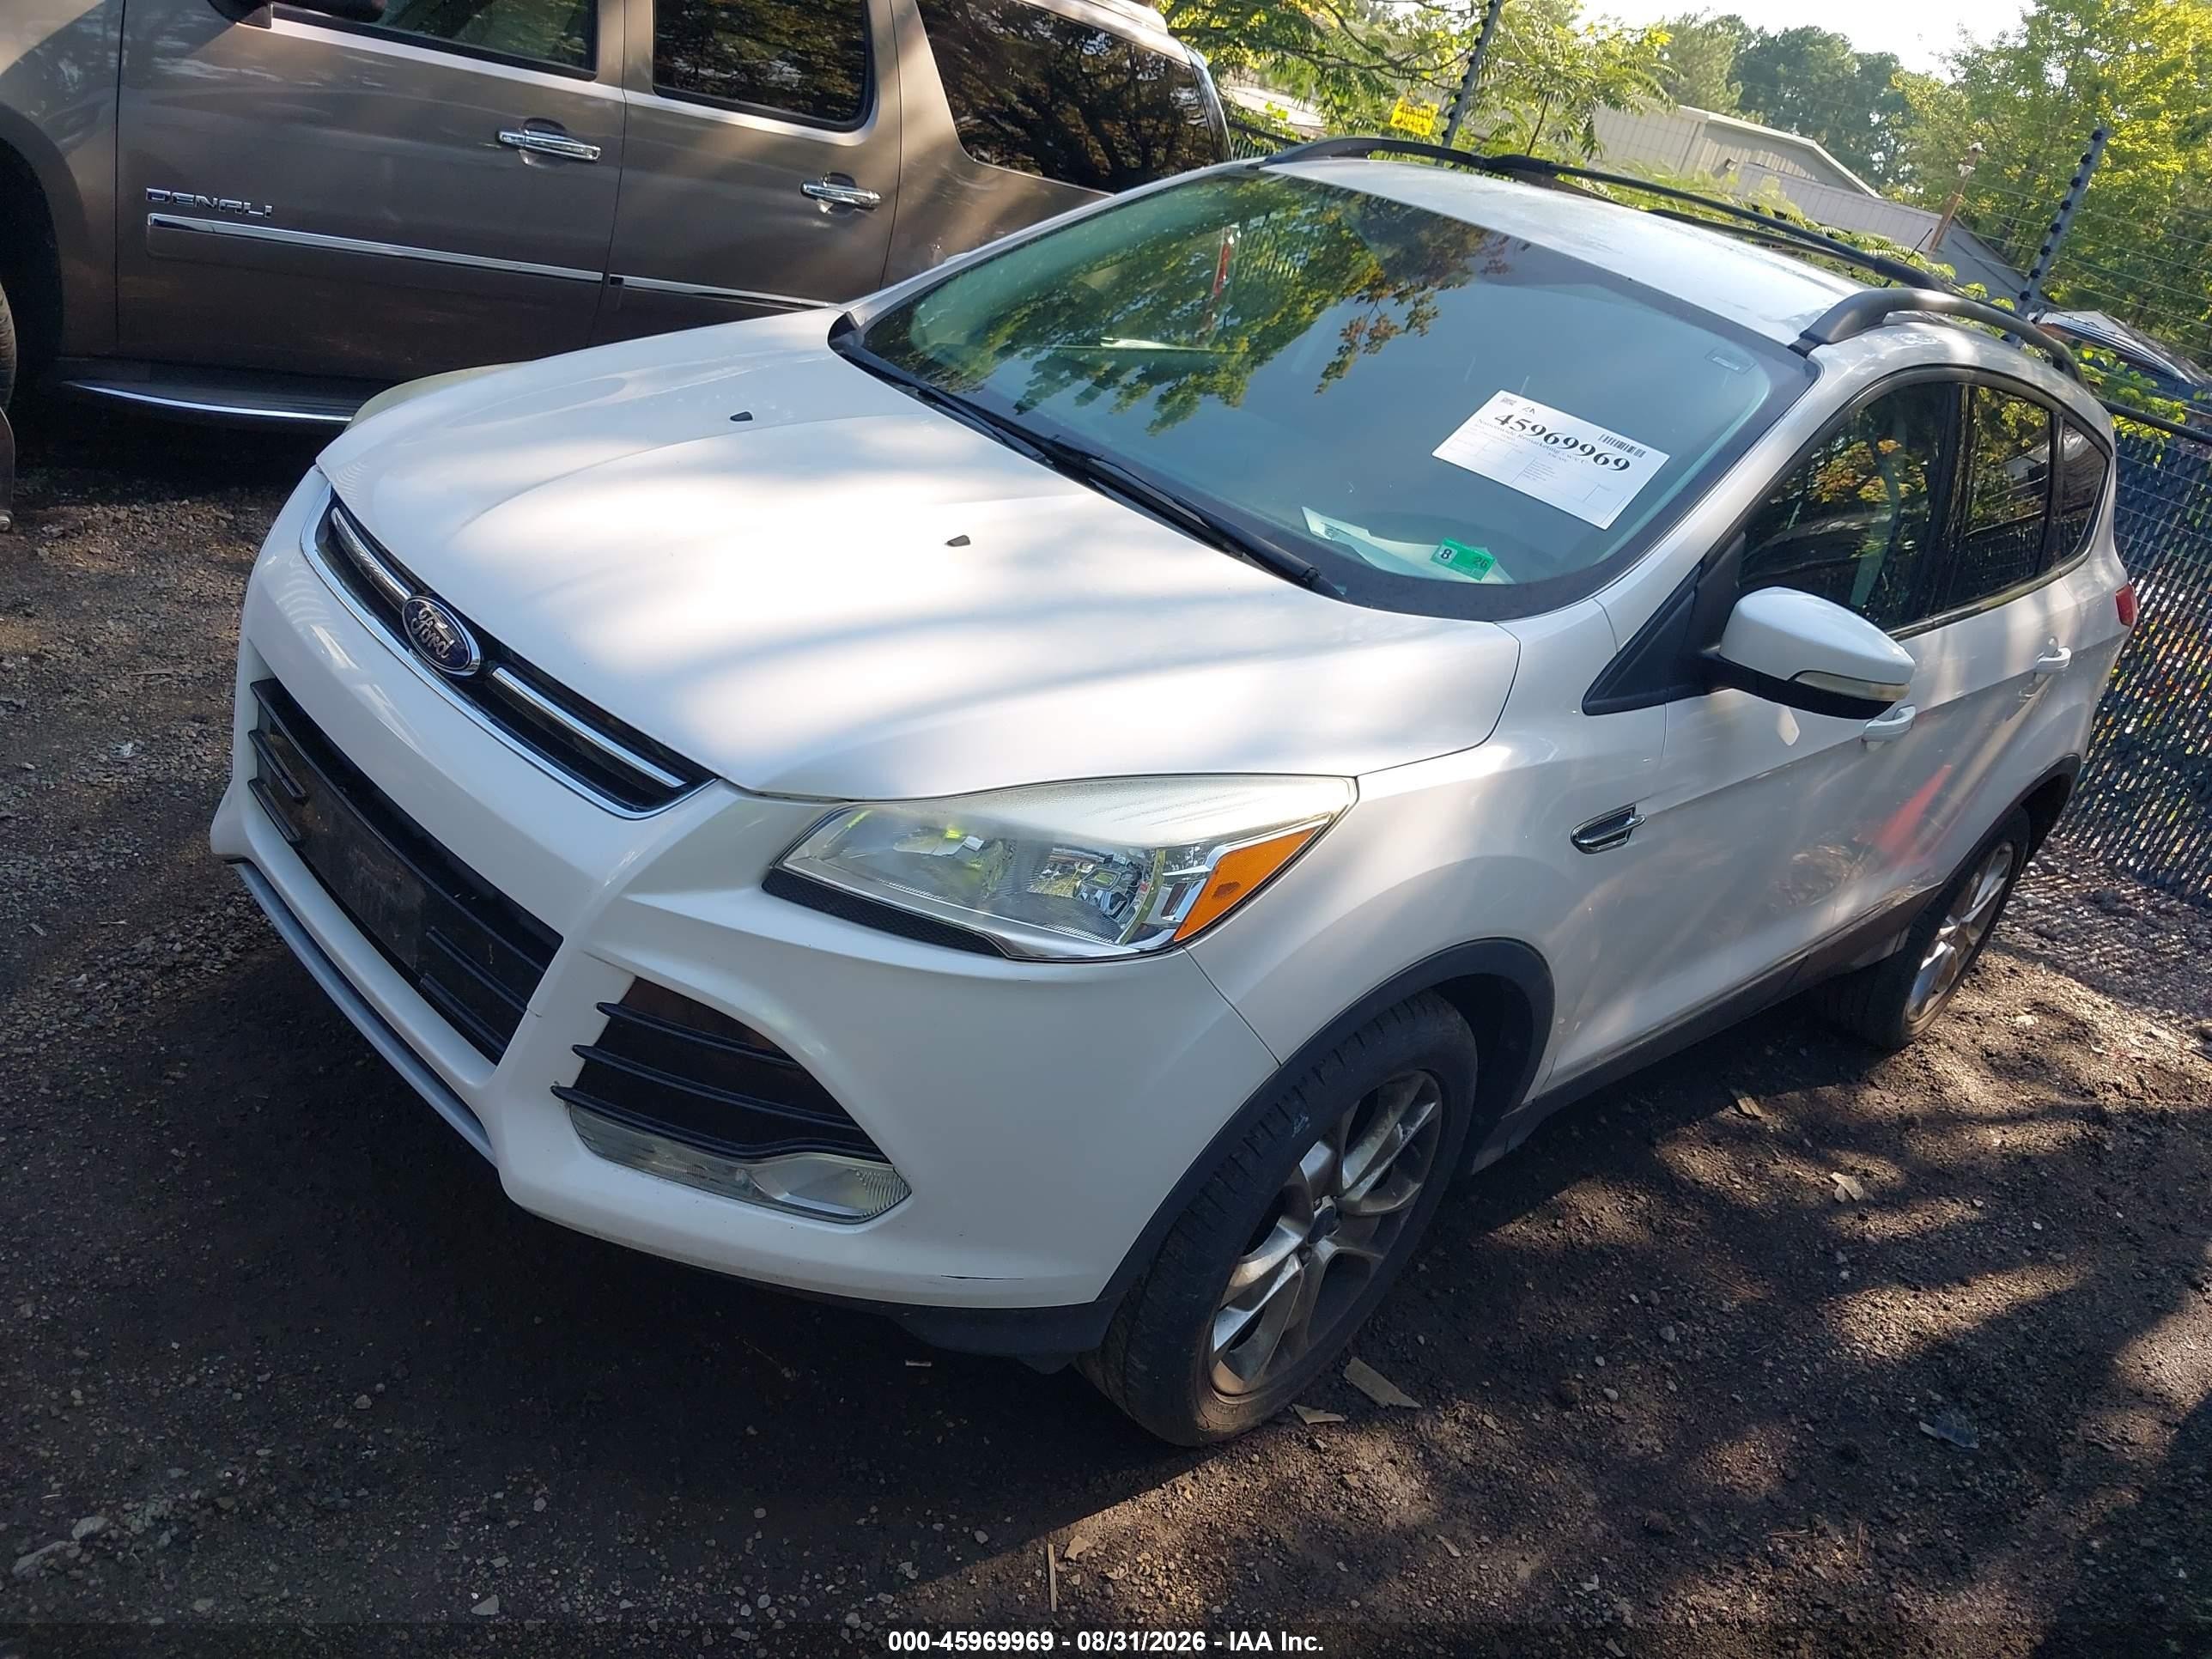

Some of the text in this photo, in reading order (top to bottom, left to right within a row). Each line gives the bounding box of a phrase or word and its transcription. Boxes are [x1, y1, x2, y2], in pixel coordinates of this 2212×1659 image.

[145, 187, 273, 218] DENALI
[1493, 414, 1631, 472] 45969969
[1441, 549, 1452, 560] 8
[410, 603, 455, 659] Ford
